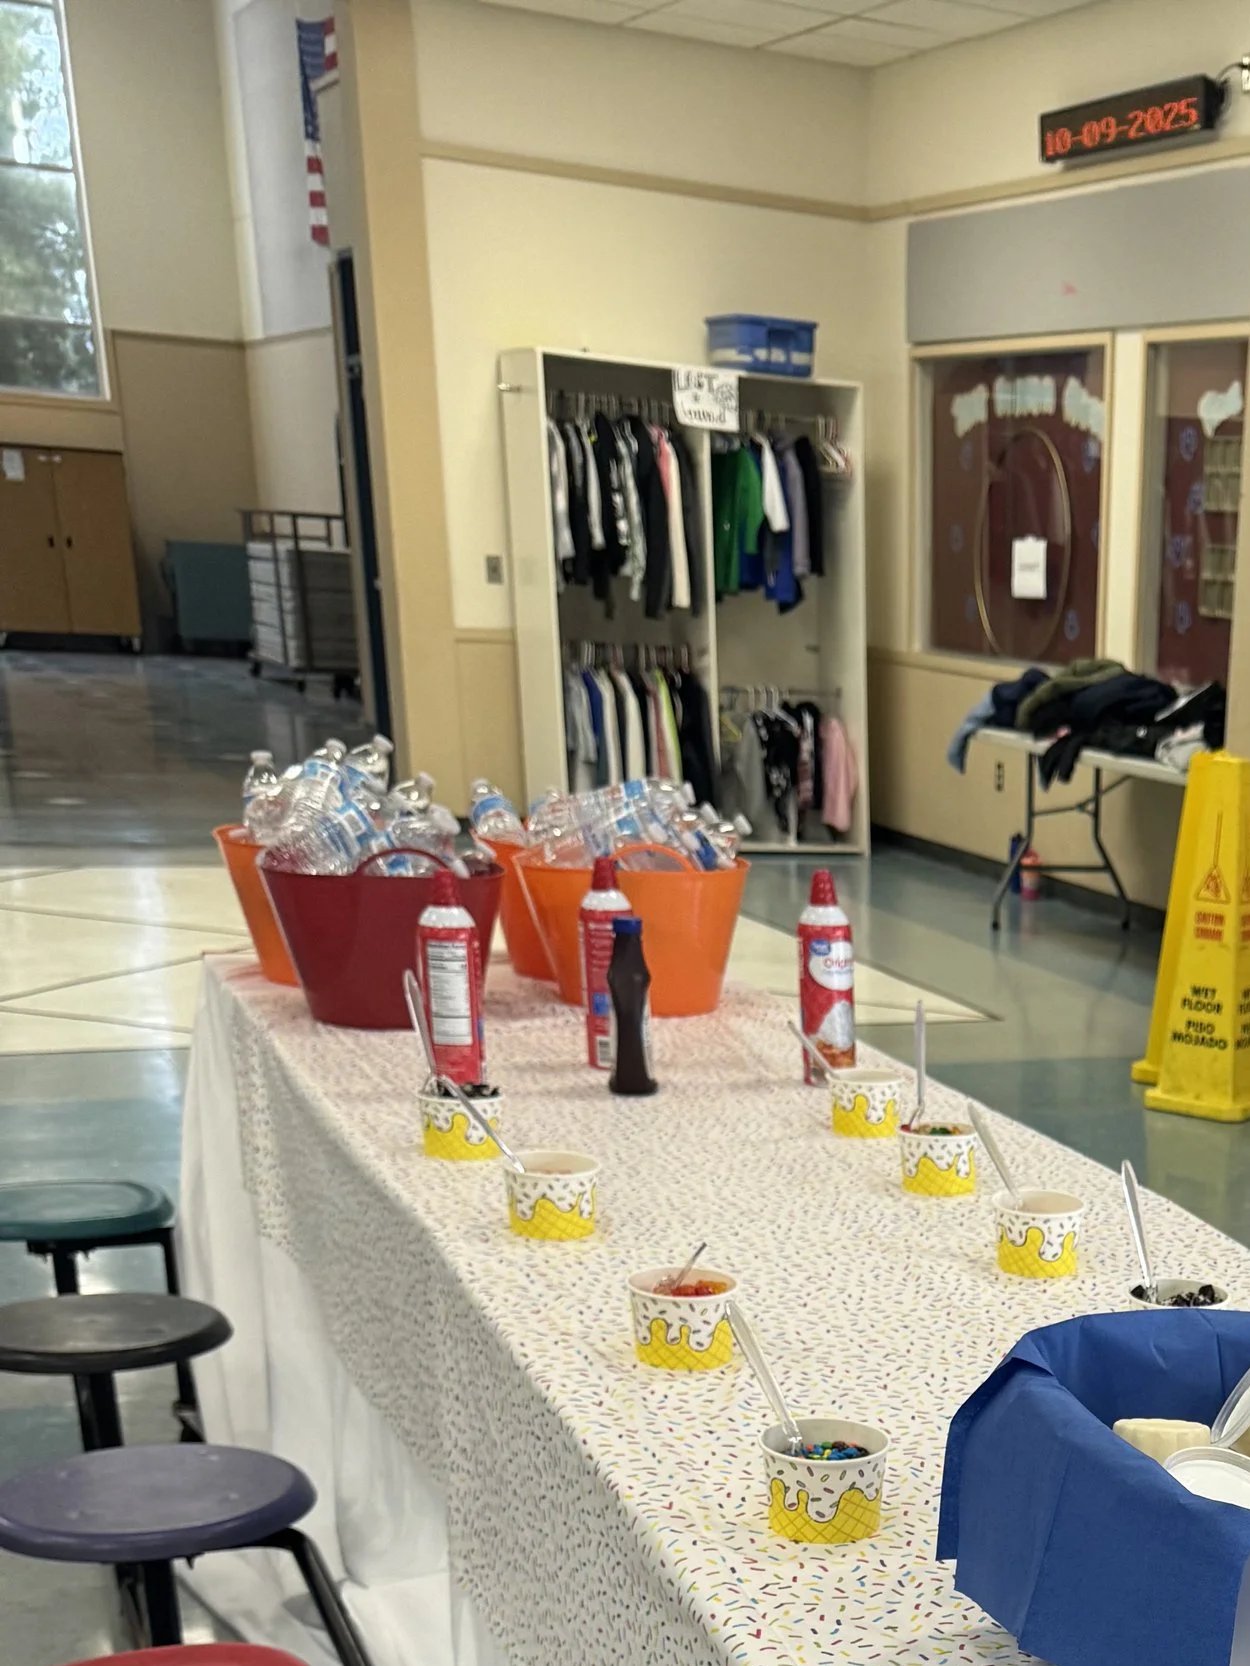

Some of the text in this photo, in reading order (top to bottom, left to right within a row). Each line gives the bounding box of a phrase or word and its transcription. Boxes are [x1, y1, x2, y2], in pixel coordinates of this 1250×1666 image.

[1045, 97, 1199, 157] 10-09-2025
[1190, 984, 1217, 1000] WET
[1180, 997, 1223, 1015] FLOOR
[1171, 1030, 1228, 1051] MOJADO
